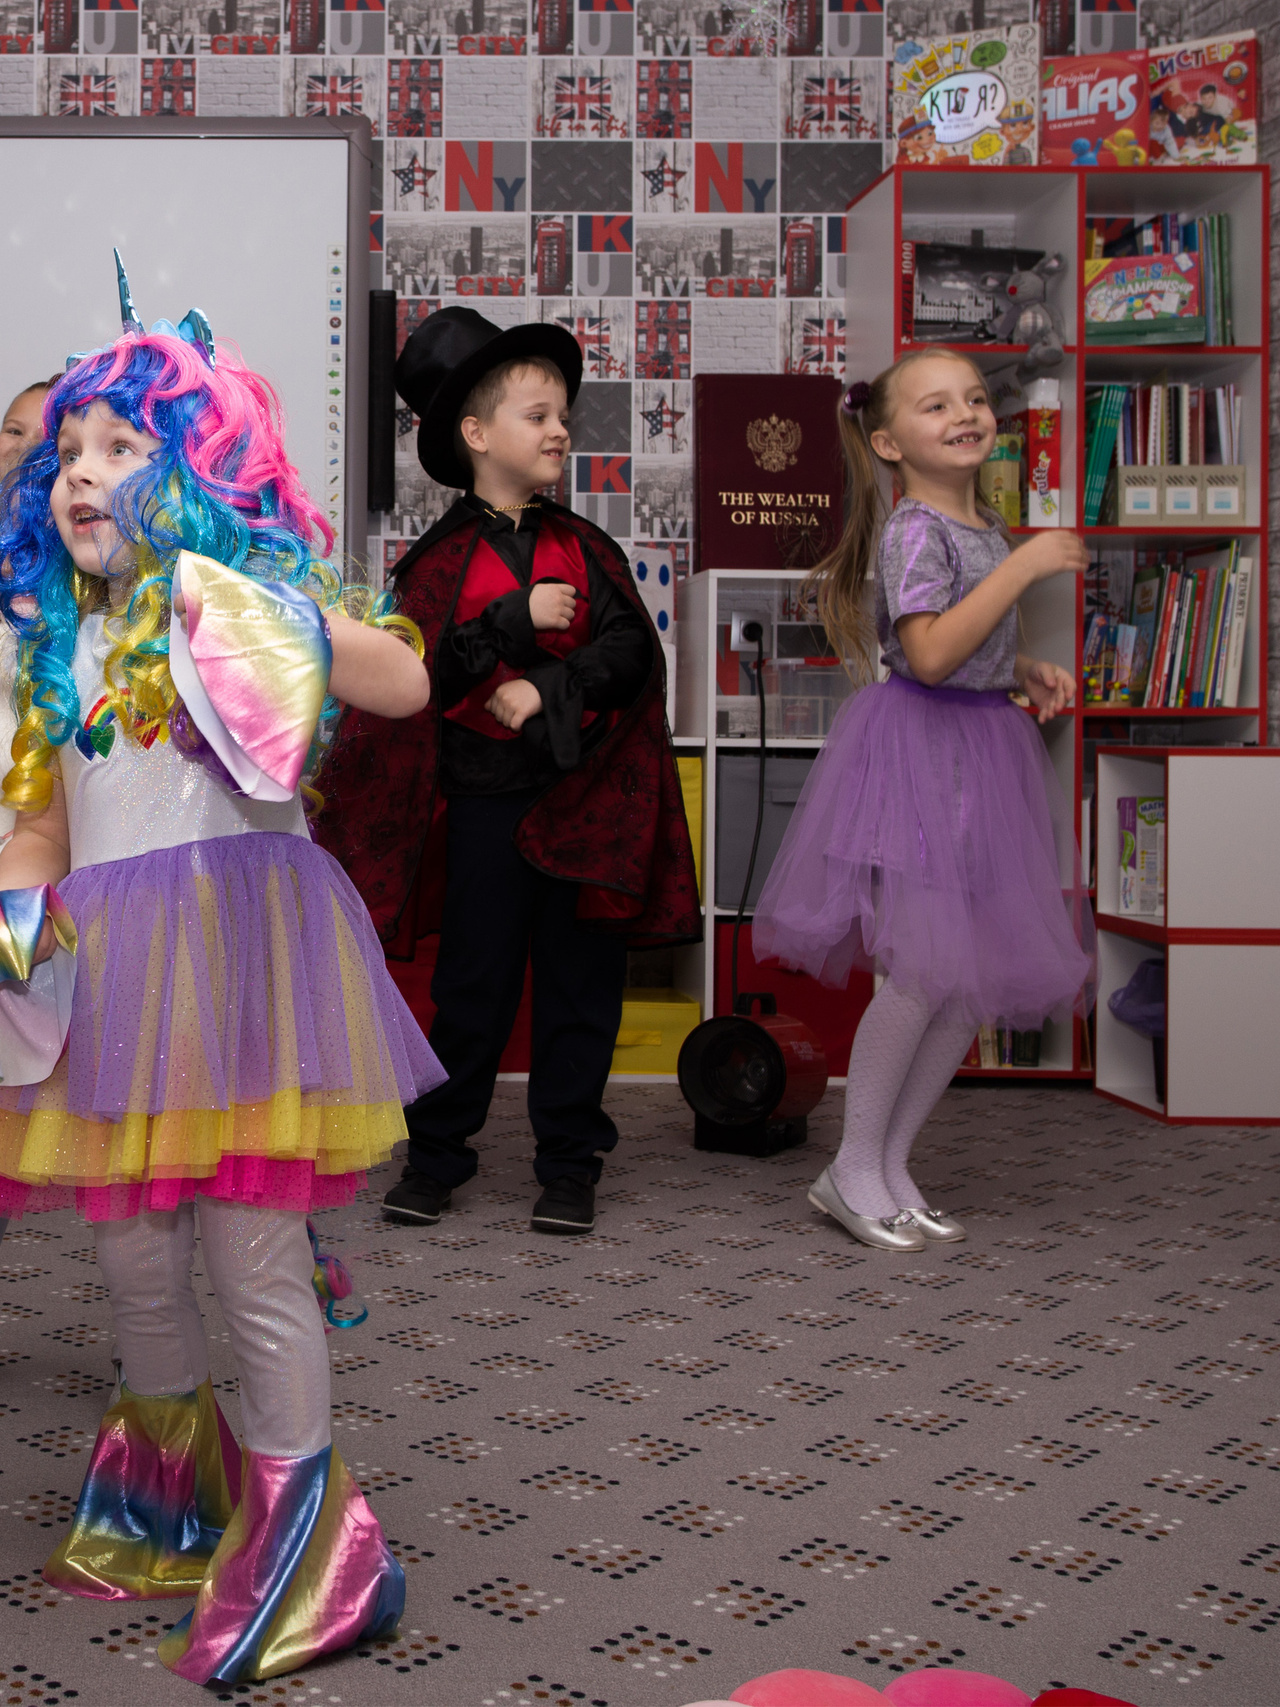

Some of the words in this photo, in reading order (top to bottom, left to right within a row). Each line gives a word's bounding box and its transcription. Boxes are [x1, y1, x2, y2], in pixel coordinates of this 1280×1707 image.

[211, 36, 279, 55] CITY
[459, 36, 527, 55] CITY
[1053, 67, 1100, 89] Original
[930, 86, 968, 122] КТО
[974, 83, 998, 118] Я?
[1042, 74, 1138, 121] ALIAS
[901, 242, 913, 274] 1000
[1104, 262, 1173, 286] ENGLISH
[457, 277, 525, 296] CITY
[707, 278, 775, 297] CITY
[1110, 280, 1194, 300] CHAMPIONSHIP
[718, 491, 755, 506] THE
[757, 492, 831, 508] WEALTH
[731, 510, 756, 525] OF
[759, 511, 819, 526] RUSSIA
